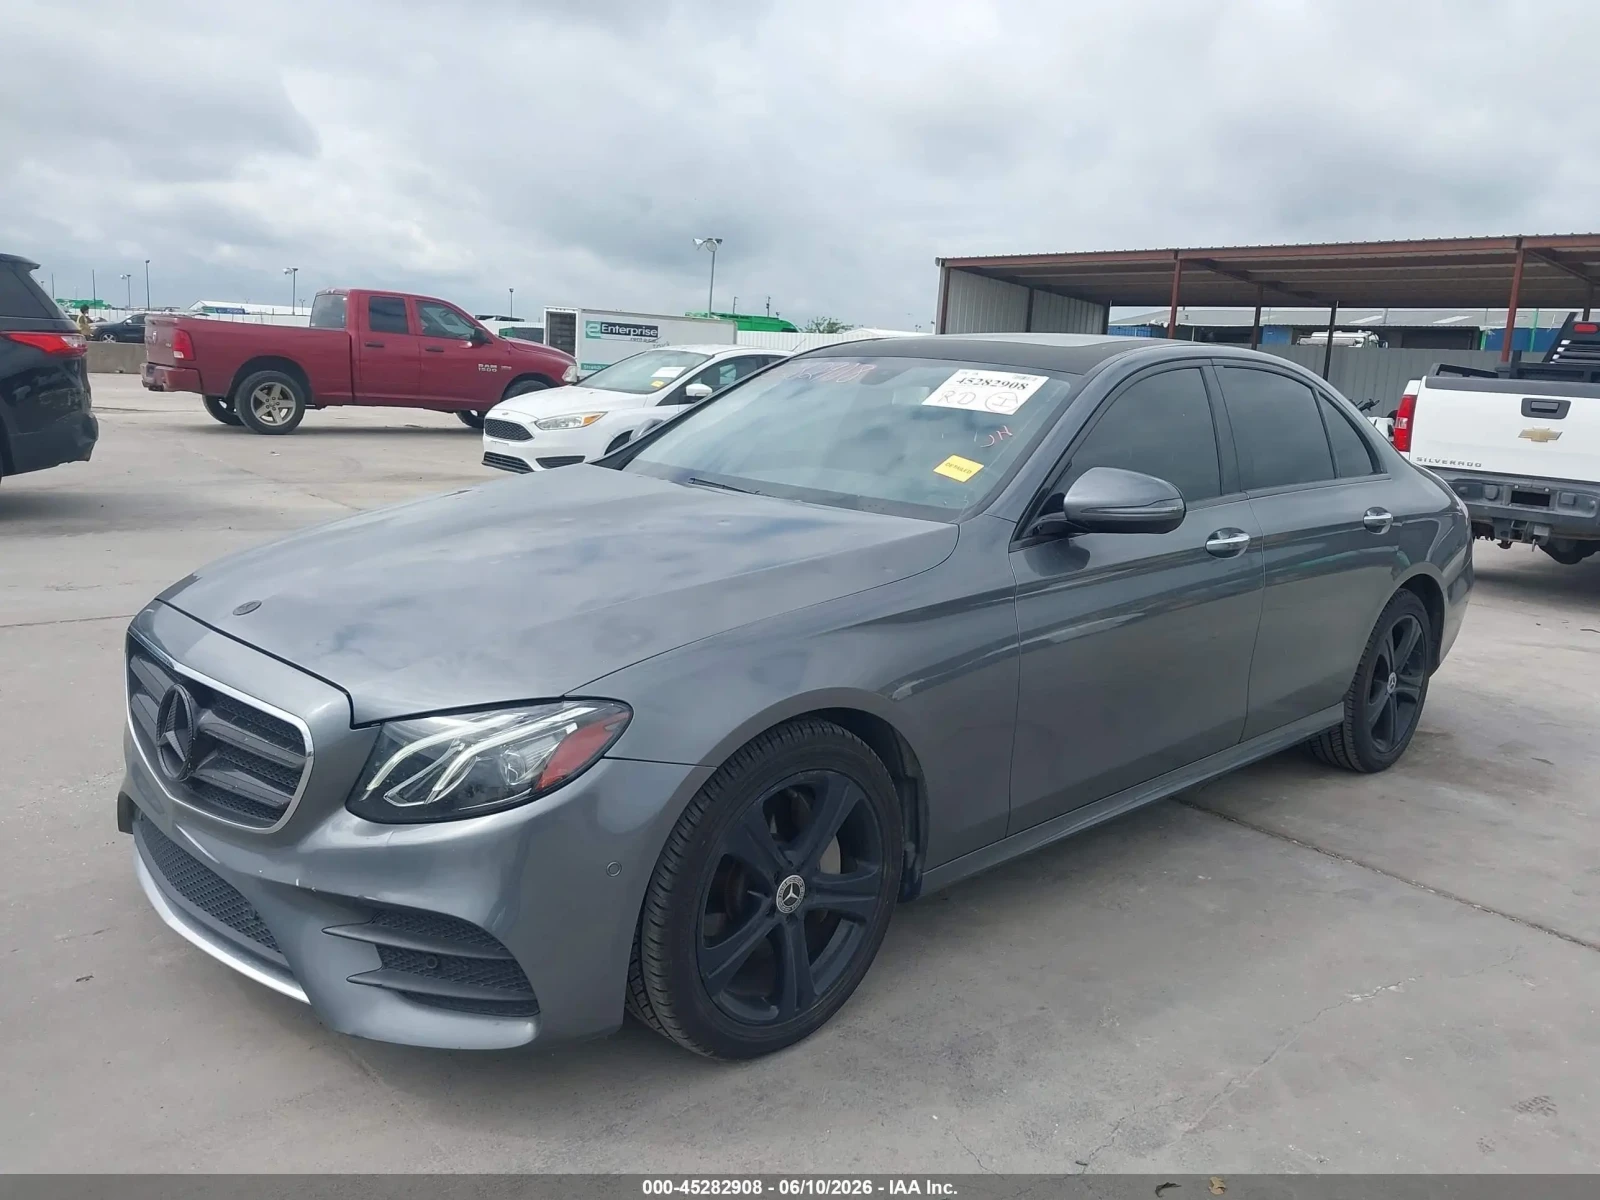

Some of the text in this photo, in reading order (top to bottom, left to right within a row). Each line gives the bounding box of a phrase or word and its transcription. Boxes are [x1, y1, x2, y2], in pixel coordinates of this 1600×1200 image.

[601, 324, 658, 337] Enterprise
[956, 377, 1029, 391] 45282908
[1416, 456, 1482, 468] SILVERADO
